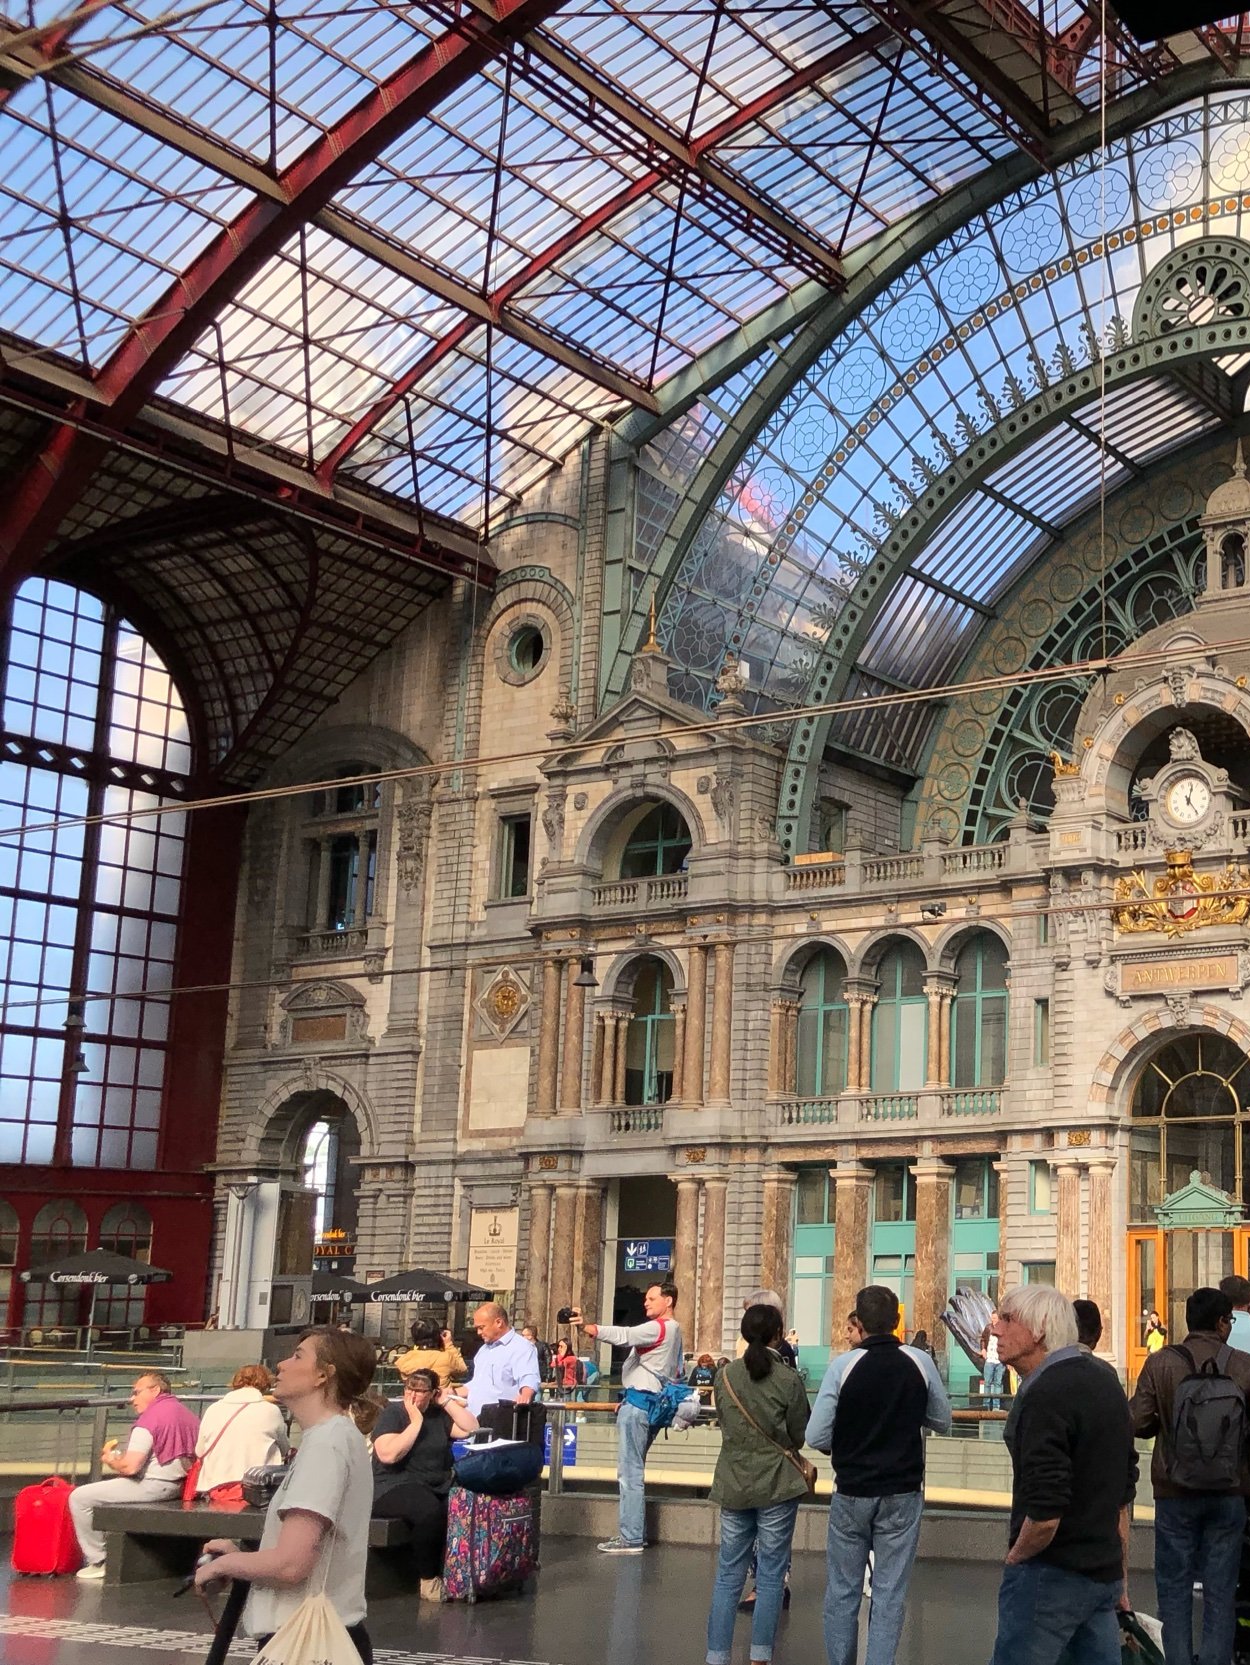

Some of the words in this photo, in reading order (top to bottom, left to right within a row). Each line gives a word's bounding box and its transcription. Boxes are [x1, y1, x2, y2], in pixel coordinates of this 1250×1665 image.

[1133, 963, 1227, 984] ANTWERPEN
[313, 1245, 340, 1256] OYAL
[50, 1271, 93, 1283] Corsendonk
[94, 1271, 109, 1283] bier
[310, 1289, 342, 1302] orsendon
[370, 1289, 411, 1302] Corsendonk
[412, 1290, 426, 1302] bier
